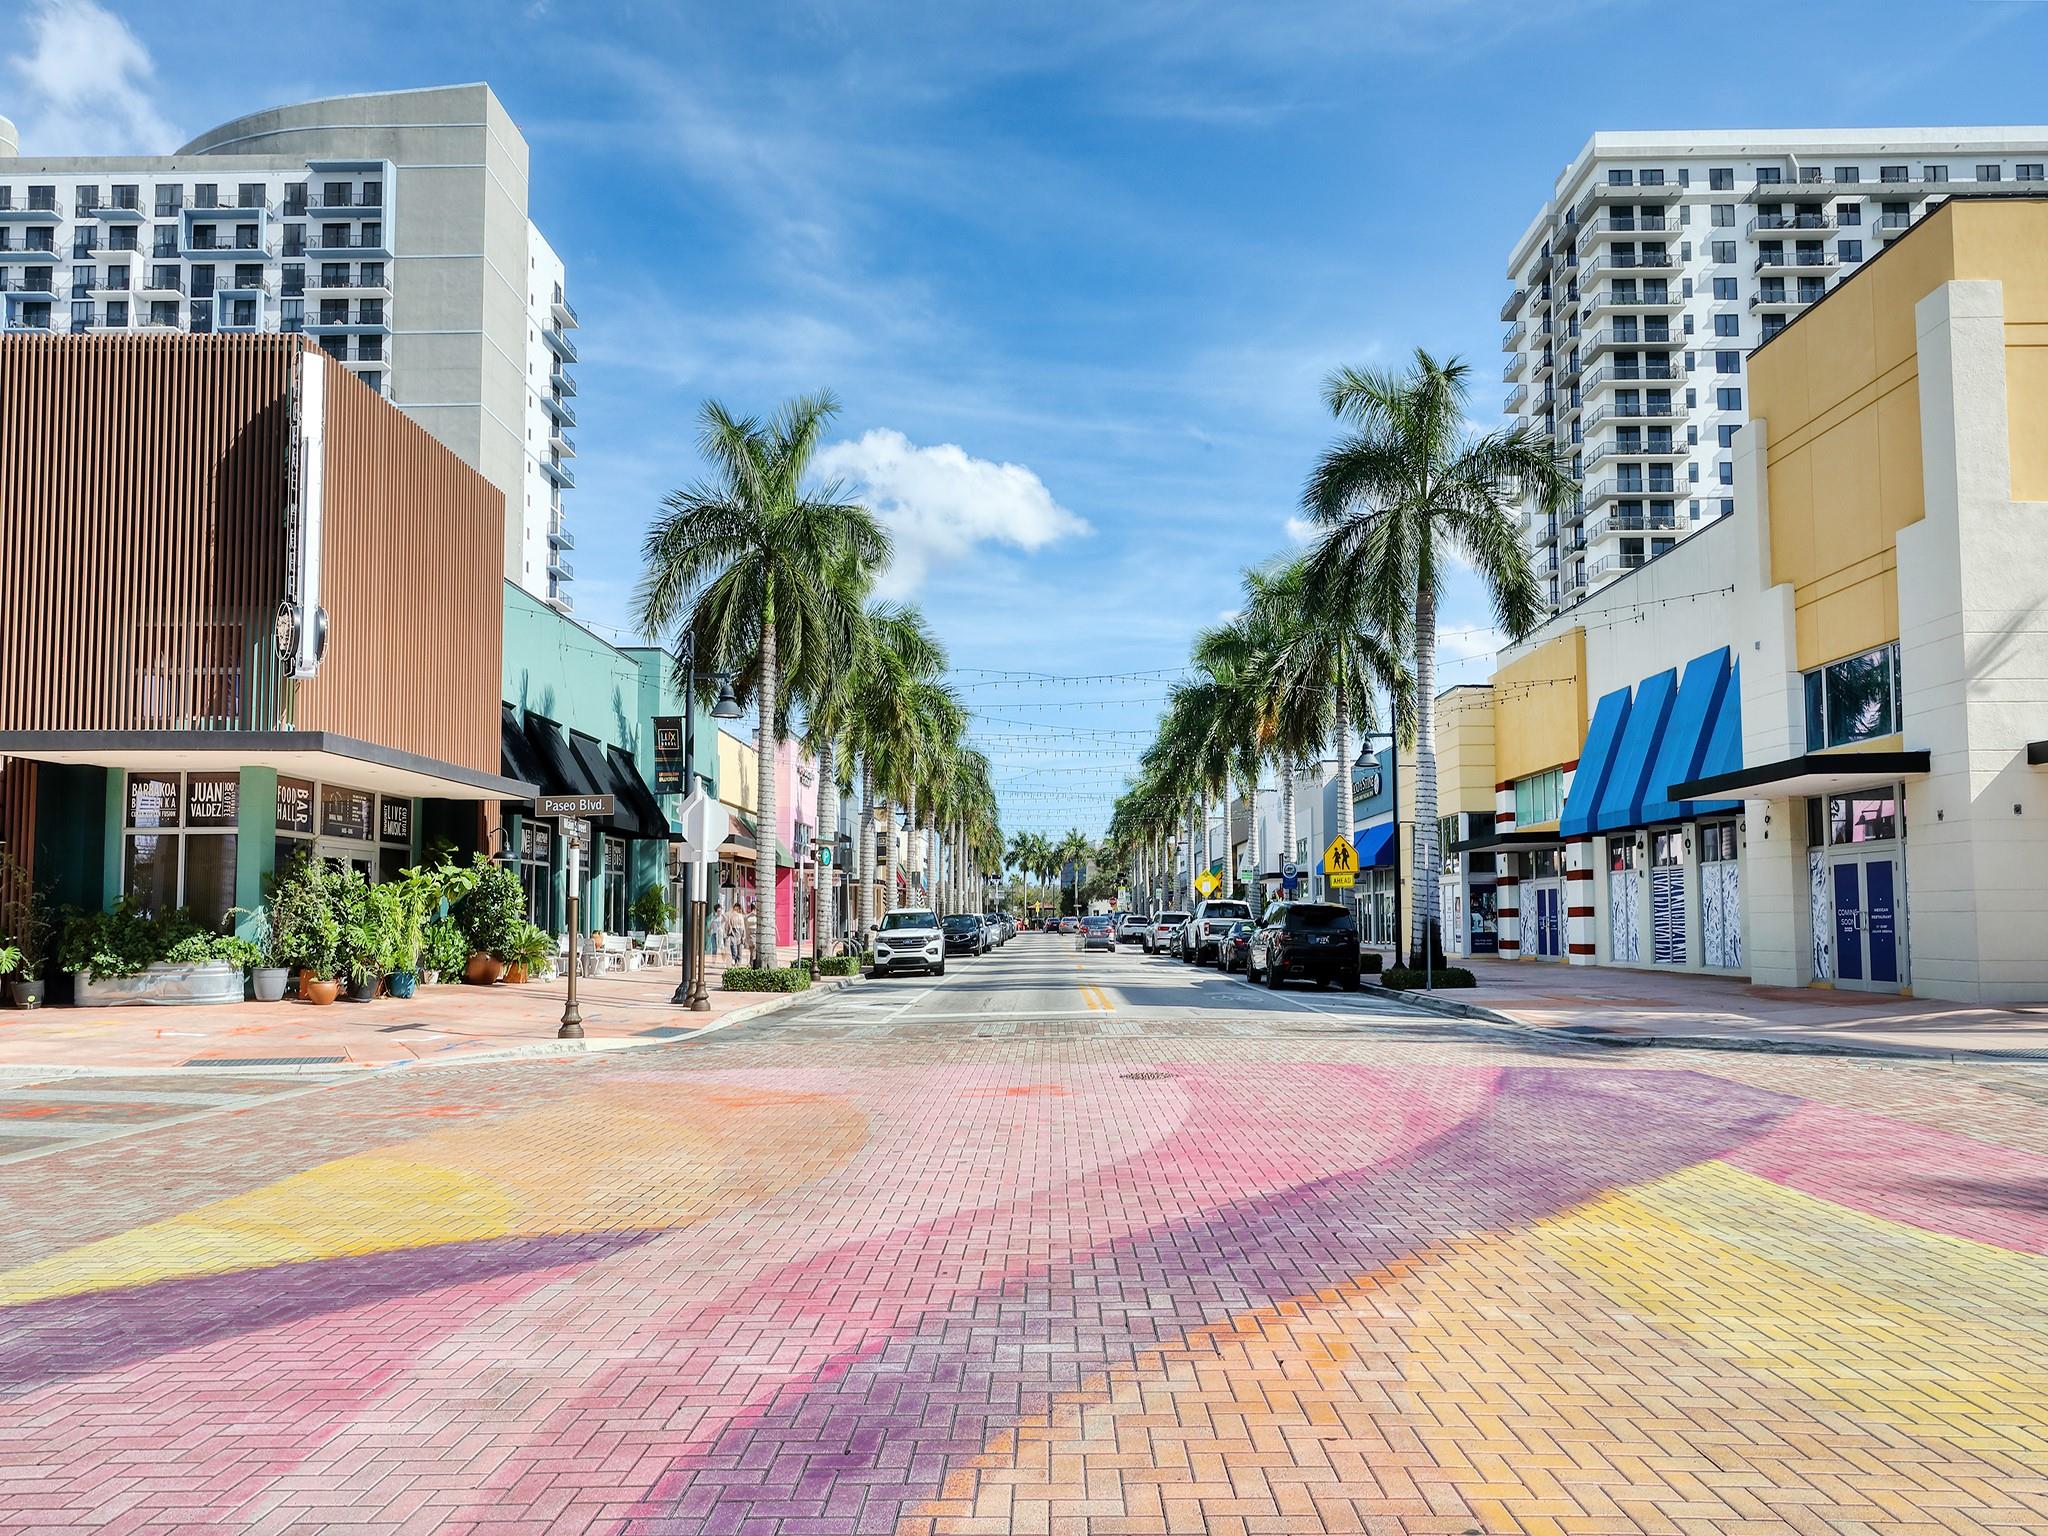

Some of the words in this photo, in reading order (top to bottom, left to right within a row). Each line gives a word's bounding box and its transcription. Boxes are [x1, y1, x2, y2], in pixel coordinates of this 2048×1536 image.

[191, 782, 222, 802] JUAN
[277, 785, 297, 804] FOOD
[191, 803, 222, 817] VALDEZ
[277, 803, 296, 822] HALL
[297, 789, 309, 824] BAR
[387, 804, 402, 821] LIVE
[545, 799, 576, 812] Paseo
[579, 798, 605, 811] Blvd.
